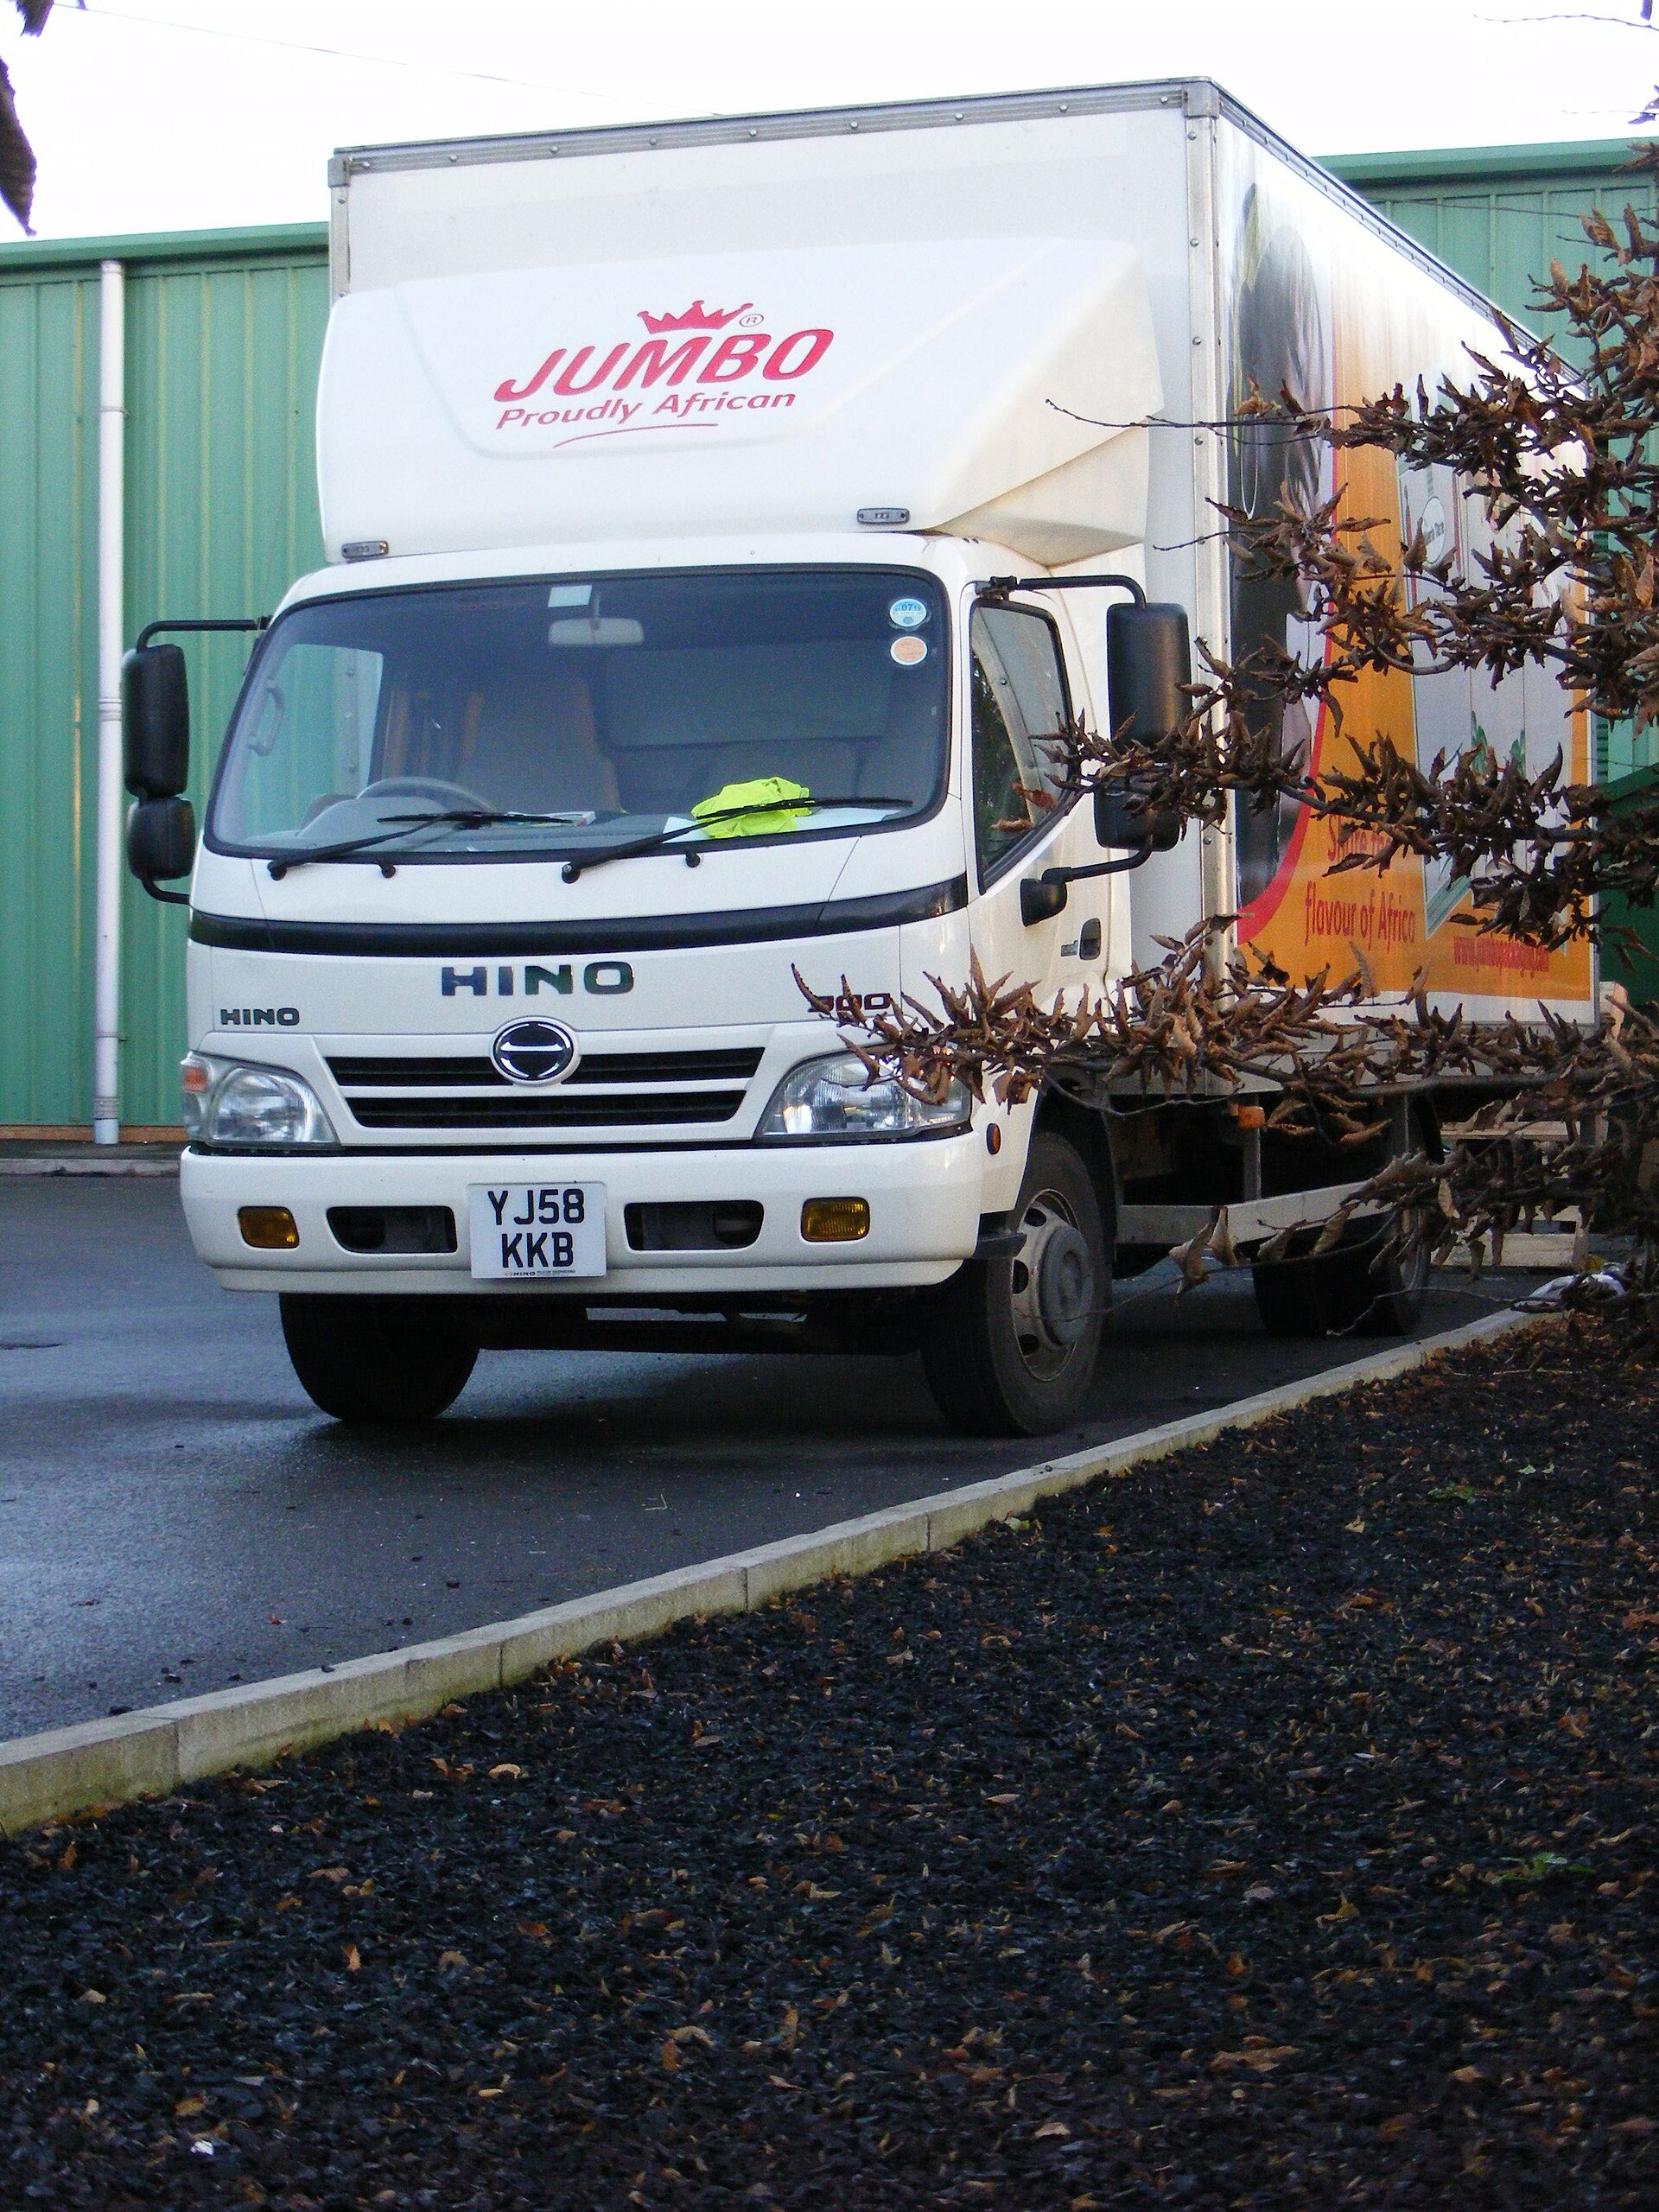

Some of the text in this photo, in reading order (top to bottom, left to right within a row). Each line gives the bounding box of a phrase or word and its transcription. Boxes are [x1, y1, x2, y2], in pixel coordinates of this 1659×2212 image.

[493, 328, 835, 402] JUMBO
[495, 391, 796, 429] Proudly African
[1304, 880, 1416, 954] flavour of Africa
[442, 962, 634, 996] HINO
[219, 1007, 301, 1026] HINO
[487, 1188, 585, 1226] YJ58
[501, 1231, 574, 1268] KKB
